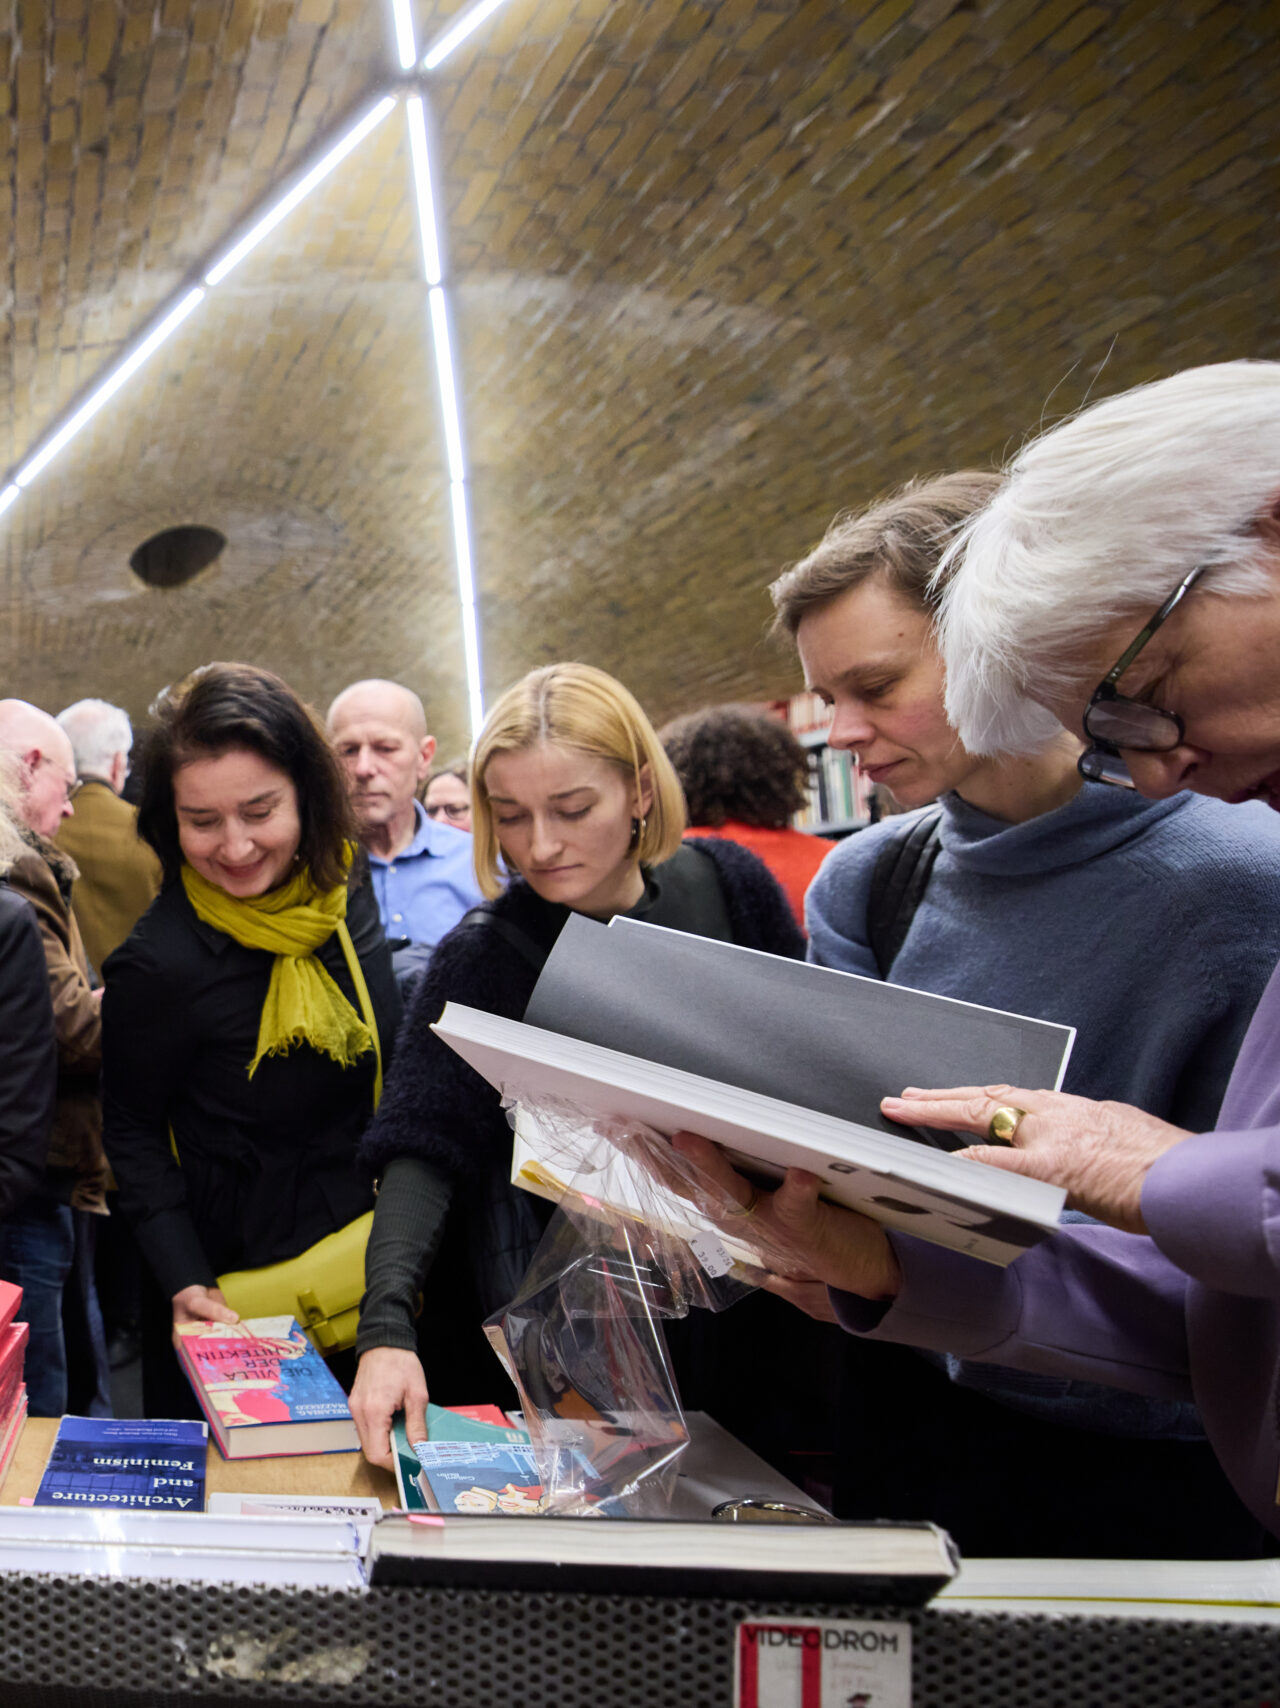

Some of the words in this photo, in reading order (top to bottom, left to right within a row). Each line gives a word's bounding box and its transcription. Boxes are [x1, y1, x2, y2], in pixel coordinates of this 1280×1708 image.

[244, 1358, 281, 1368] DER
[223, 1370, 278, 1381] VILLA
[283, 1366, 313, 1378] DIE
[93, 1457, 195, 1471] Feminism
[153, 1478, 194, 1488] and
[51, 1491, 193, 1508] Architecture
[743, 1626, 899, 1654] VIDEODROM
